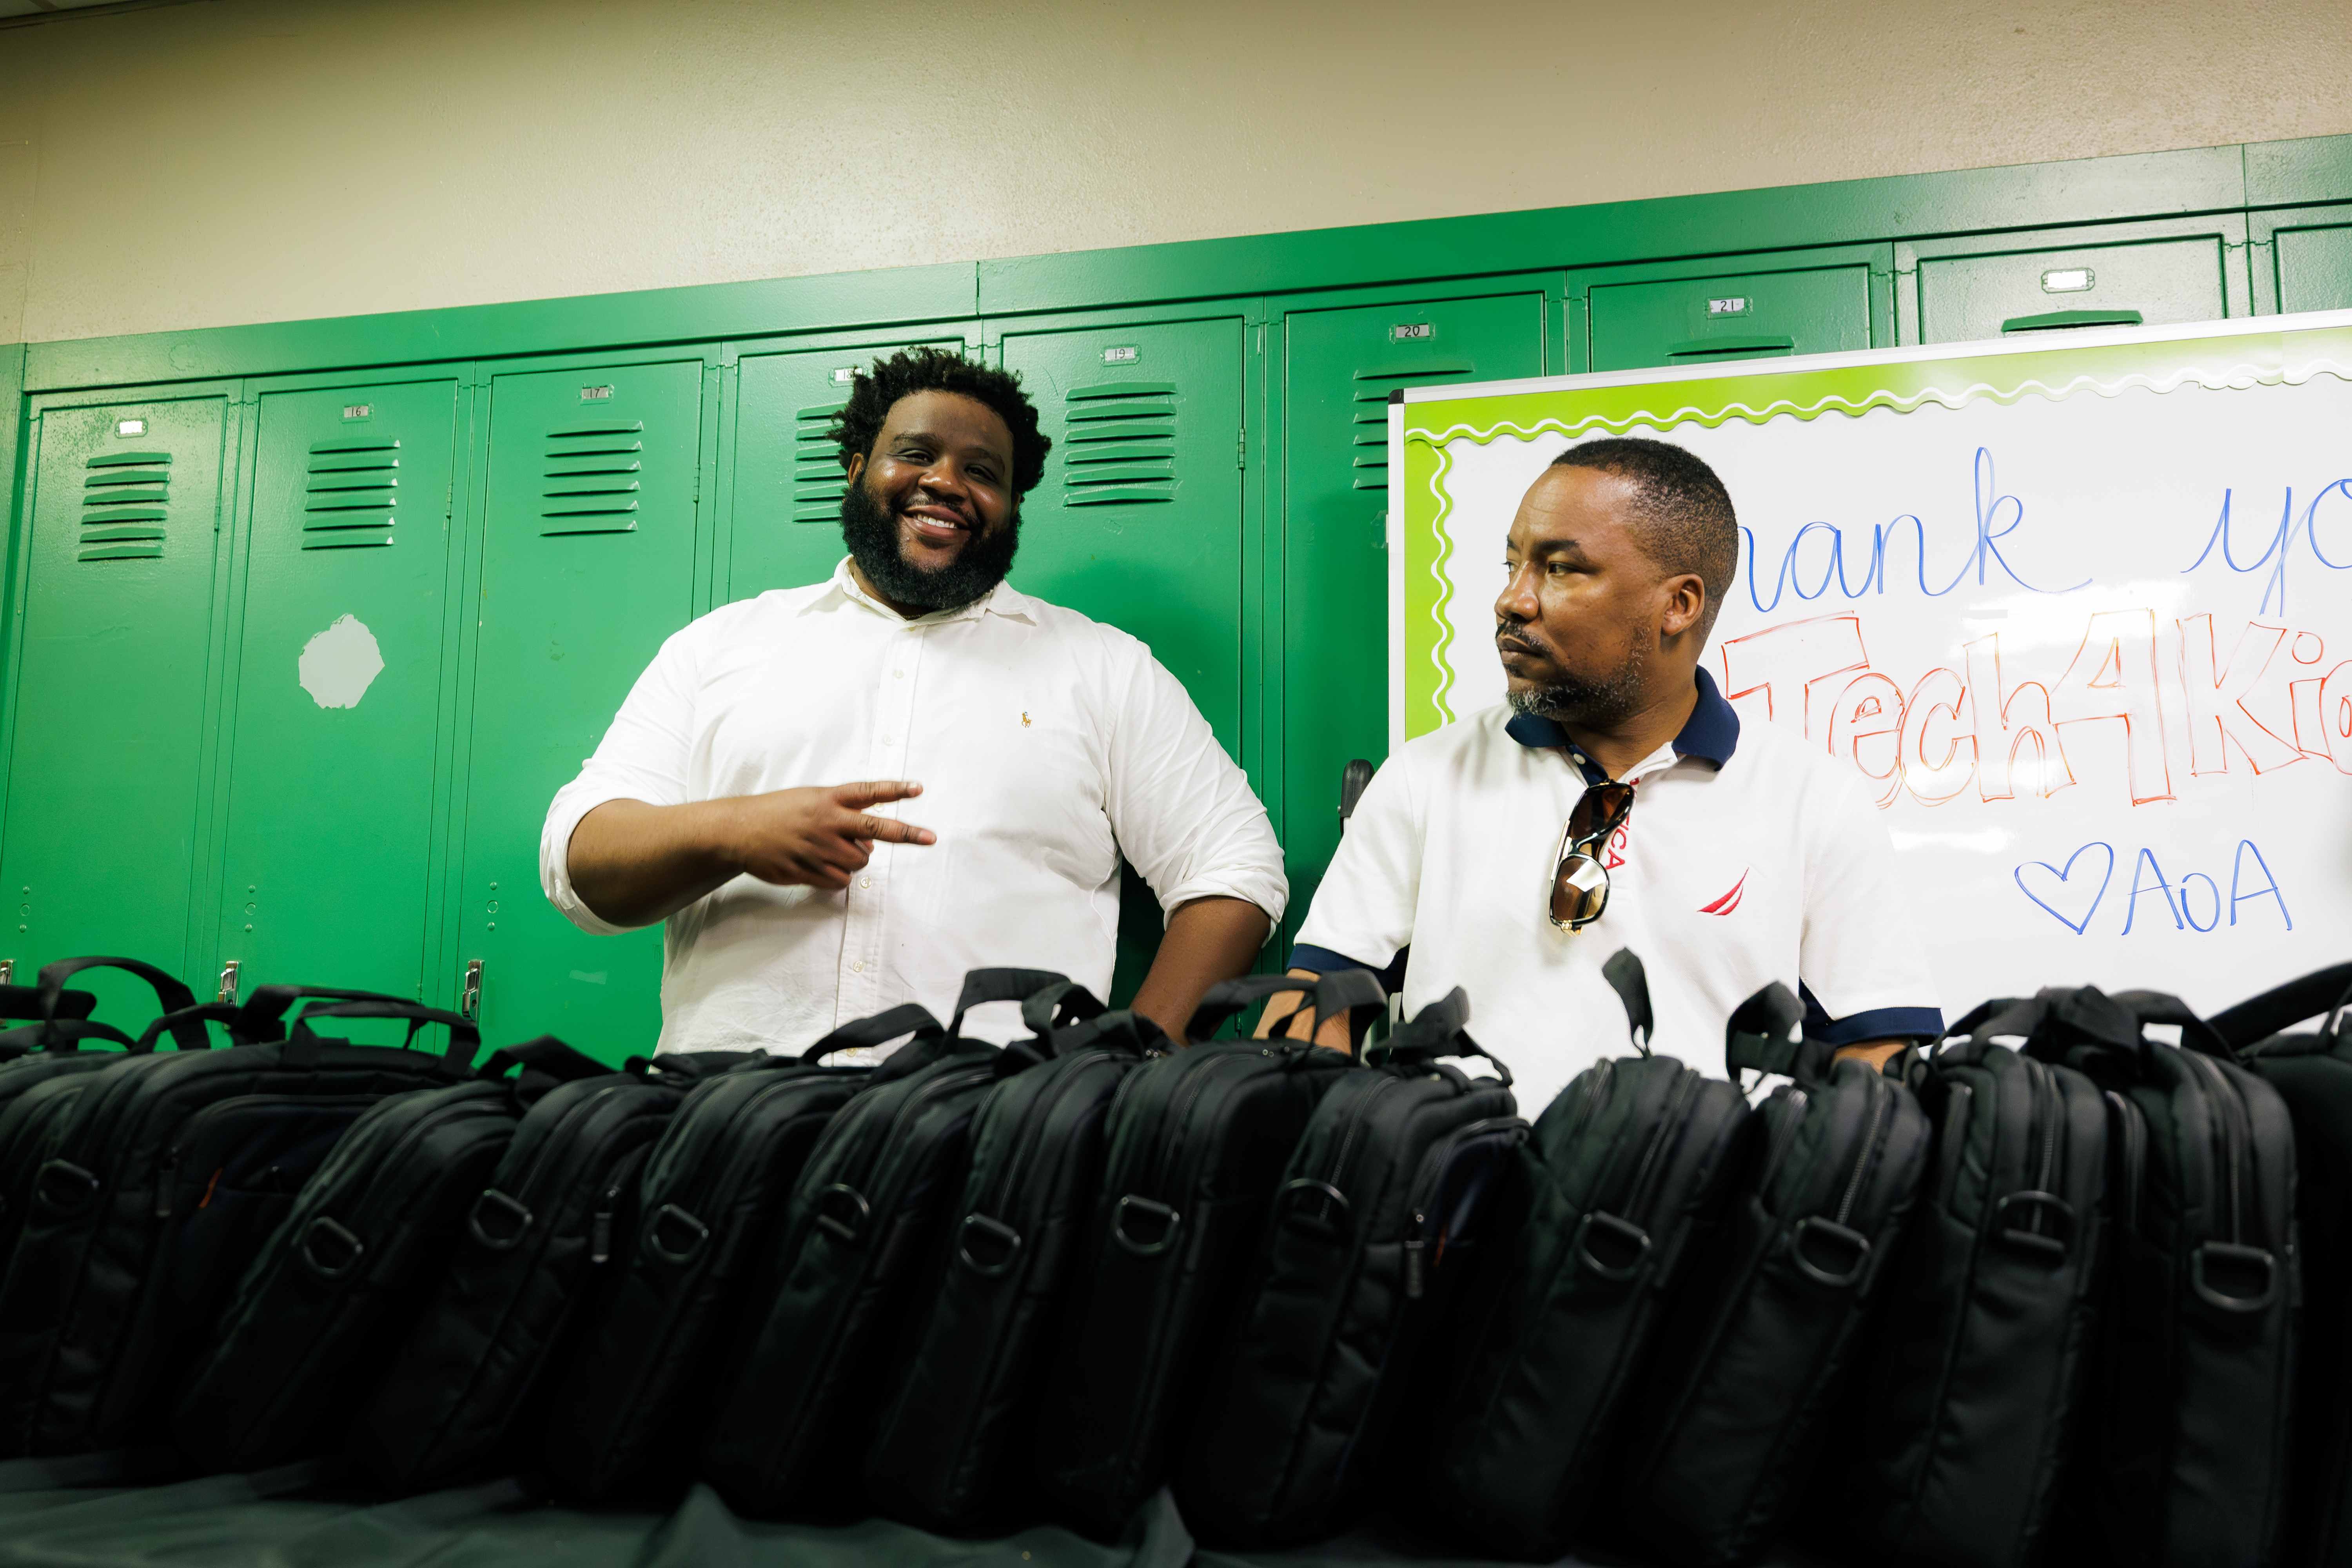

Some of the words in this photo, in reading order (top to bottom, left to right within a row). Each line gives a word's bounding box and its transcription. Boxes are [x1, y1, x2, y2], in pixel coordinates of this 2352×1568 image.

[1720, 300, 1733, 311] 21
[1405, 326, 1419, 337] 20
[1115, 349, 1125, 359] 19
[844, 370, 853, 380] 18
[590, 388, 600, 398] 17
[352, 407, 361, 416] 16
